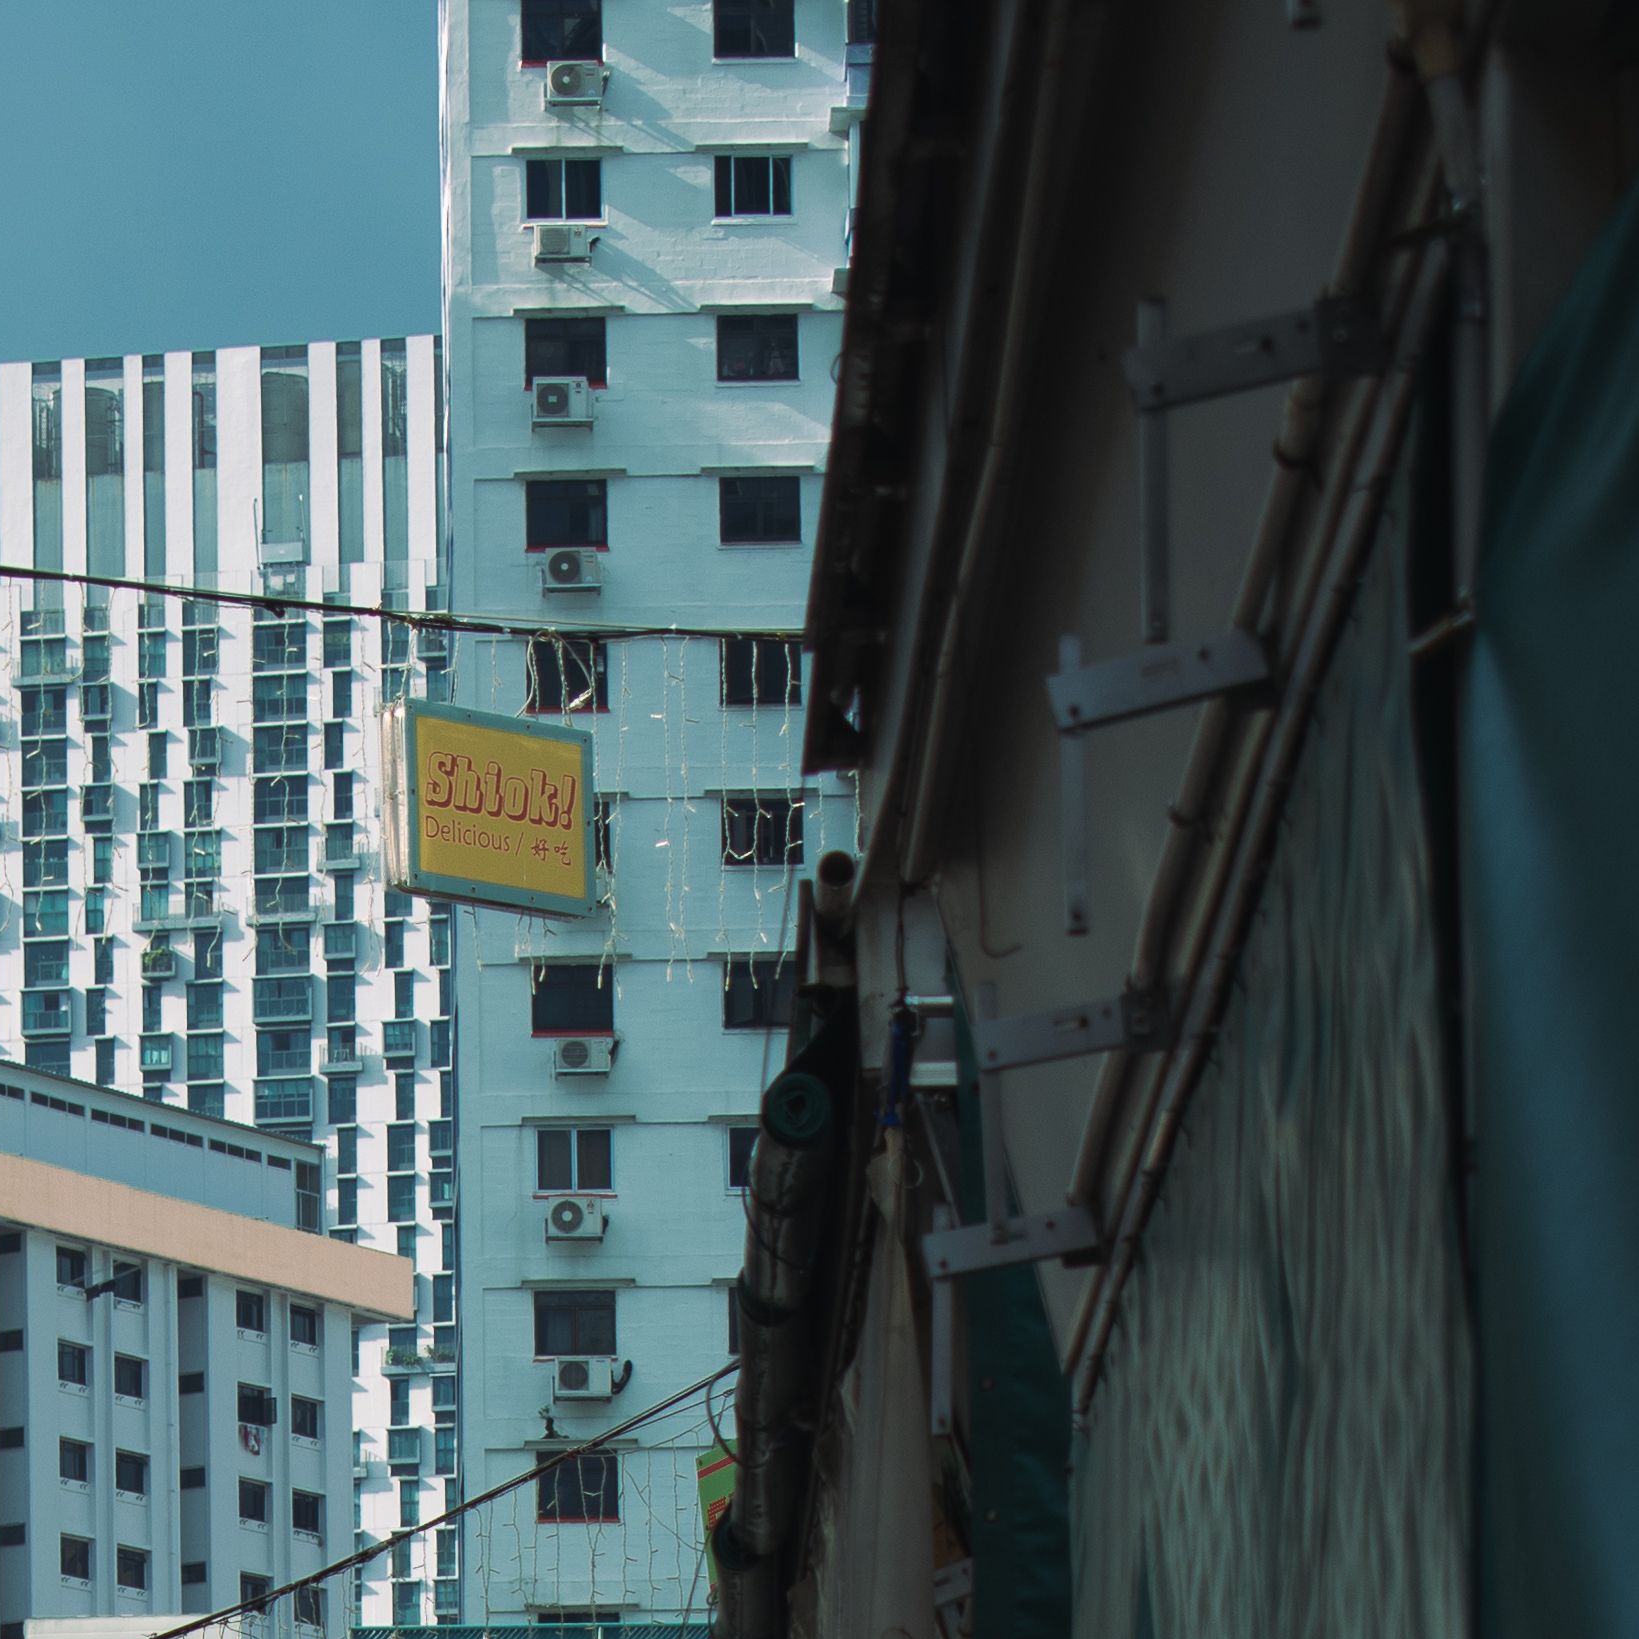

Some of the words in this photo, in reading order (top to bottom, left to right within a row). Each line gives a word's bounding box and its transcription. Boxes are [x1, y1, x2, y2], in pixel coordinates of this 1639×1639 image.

[425, 752, 576, 830] Shiok!
[426, 816, 510, 852] Delicious
[531, 837, 572, 866] 好吃
